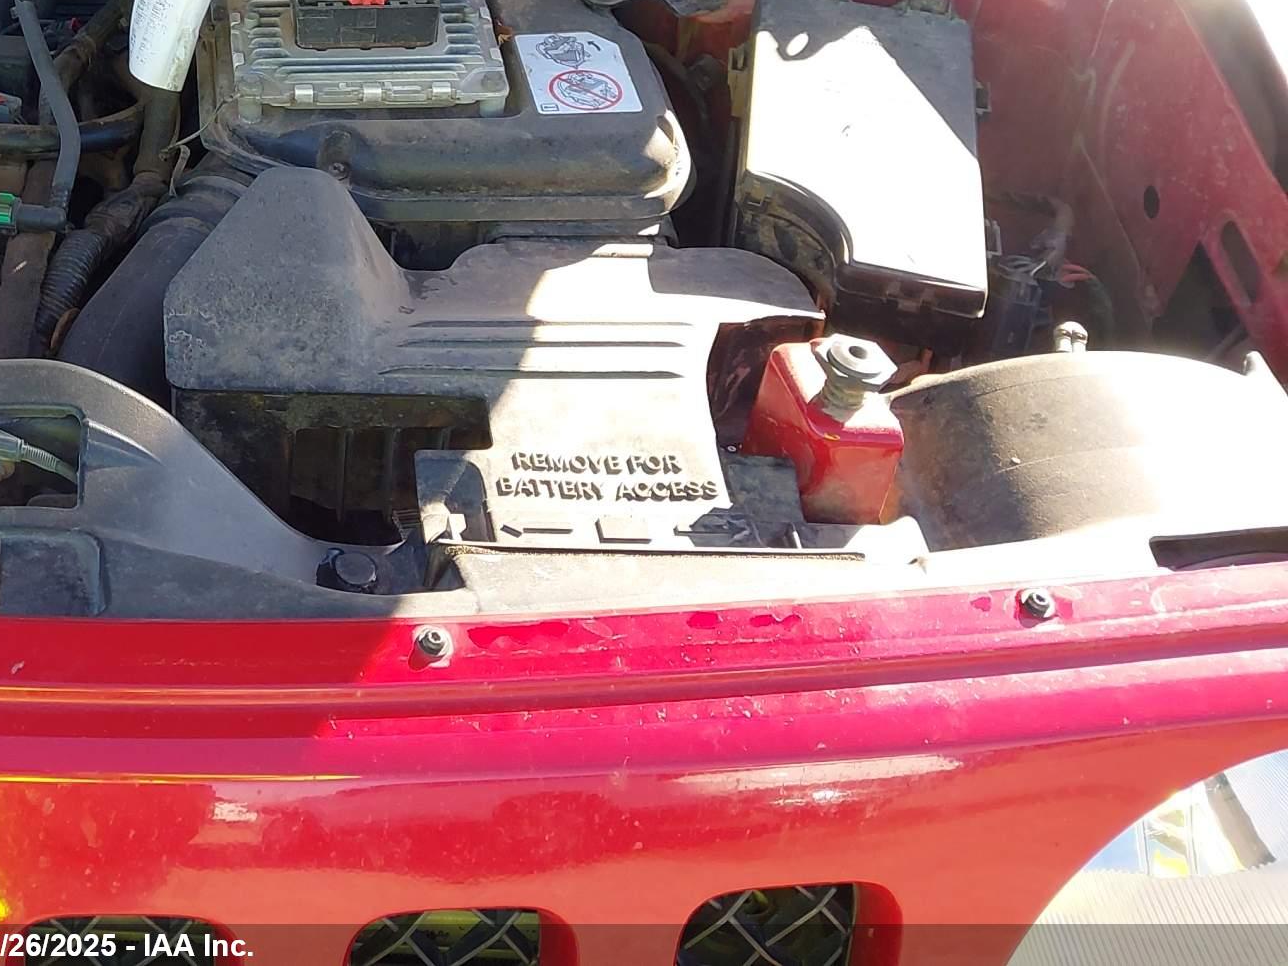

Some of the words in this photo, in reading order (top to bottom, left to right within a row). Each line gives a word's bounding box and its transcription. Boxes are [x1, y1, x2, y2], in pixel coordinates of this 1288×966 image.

[512, 452, 623, 475] REMOVE
[626, 455, 683, 475] FOR
[496, 477, 604, 501] BATTERY
[615, 481, 719, 501] ACCESS
